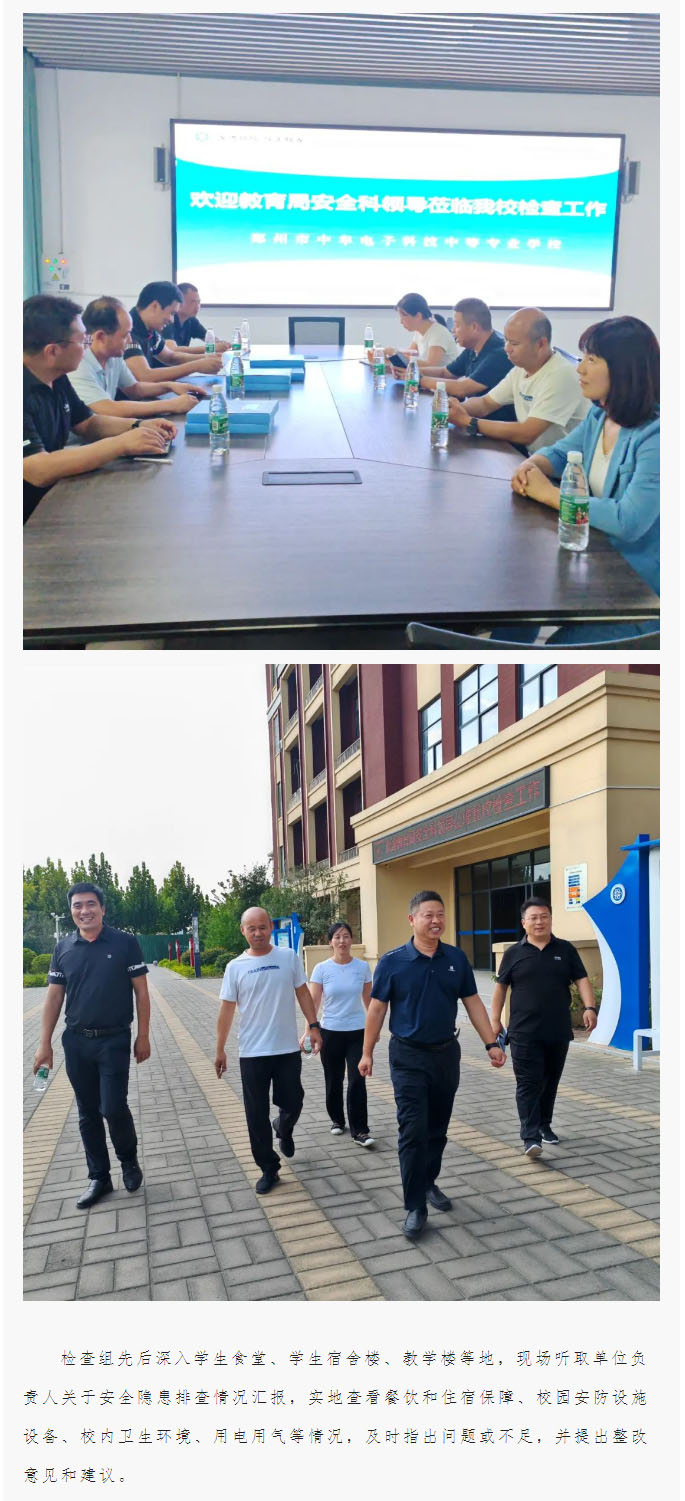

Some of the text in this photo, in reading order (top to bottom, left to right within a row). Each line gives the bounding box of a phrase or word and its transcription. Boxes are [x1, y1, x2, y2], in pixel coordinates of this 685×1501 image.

[190, 191, 607, 218] 欢迎教育局安全科领导莅临我校检查工作
[61, 1350, 645, 1366] 检查组先后深入学生食堂、学生宿舍楼、教学楼等地，现场听取单位负
[24, 1389, 646, 1405] 责人关于安全隐患排查情况汇报，实地查看餐饮和住宿保障、校园安防设施
[24, 1428, 647, 1444] 设备、校内卫生环境、用电用气等情况，及时指出问题或不足，并提出整改
[24, 1467, 129, 1483] 意见和建议。
